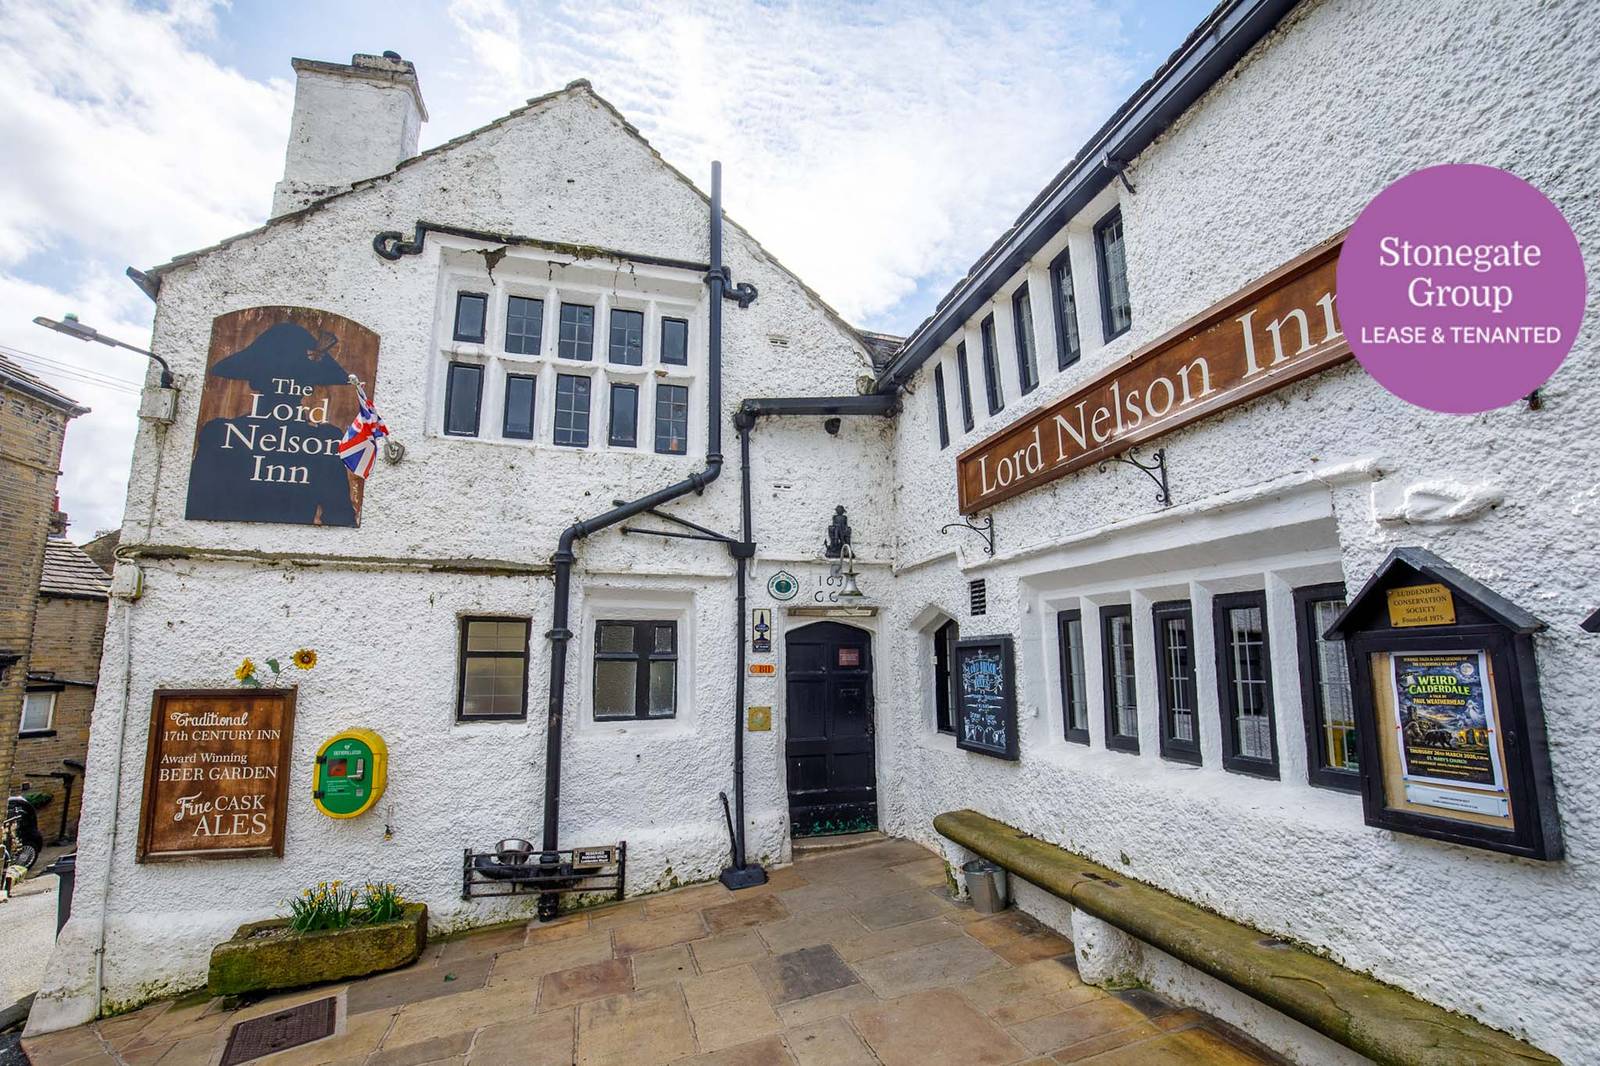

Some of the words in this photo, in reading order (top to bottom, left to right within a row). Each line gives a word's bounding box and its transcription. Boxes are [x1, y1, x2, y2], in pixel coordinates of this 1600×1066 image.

[272, 378, 313, 397] The
[247, 393, 329, 424] Lord
[978, 425, 1045, 497] Lord
[1052, 356, 1217, 463] Nelson
[221, 422, 342, 456] Nelson
[250, 455, 310, 485] Inn
[1397, 586, 1440, 597] LUDDENDEN
[1393, 595, 1447, 606] CONSERVATION
[1406, 606, 1436, 614] SOCIETY
[1417, 675, 1457, 686] WEIRD
[1408, 685, 1471, 696] CALDERDALE
[1426, 698, 1466, 706] WEATHERHEAD
[170, 712, 249, 727] Traditional
[163, 731, 189, 741] 17th
[192, 730, 254, 741] CENTURY
[256, 729, 280, 740] INN
[160, 753, 197, 764] Award
[200, 752, 248, 765] Winning
[159, 768, 204, 781] BEER
[208, 766, 278, 780] GARDEN
[174, 791, 214, 821] Fine
[214, 794, 266, 811] CASK
[192, 813, 267, 836] ALES
